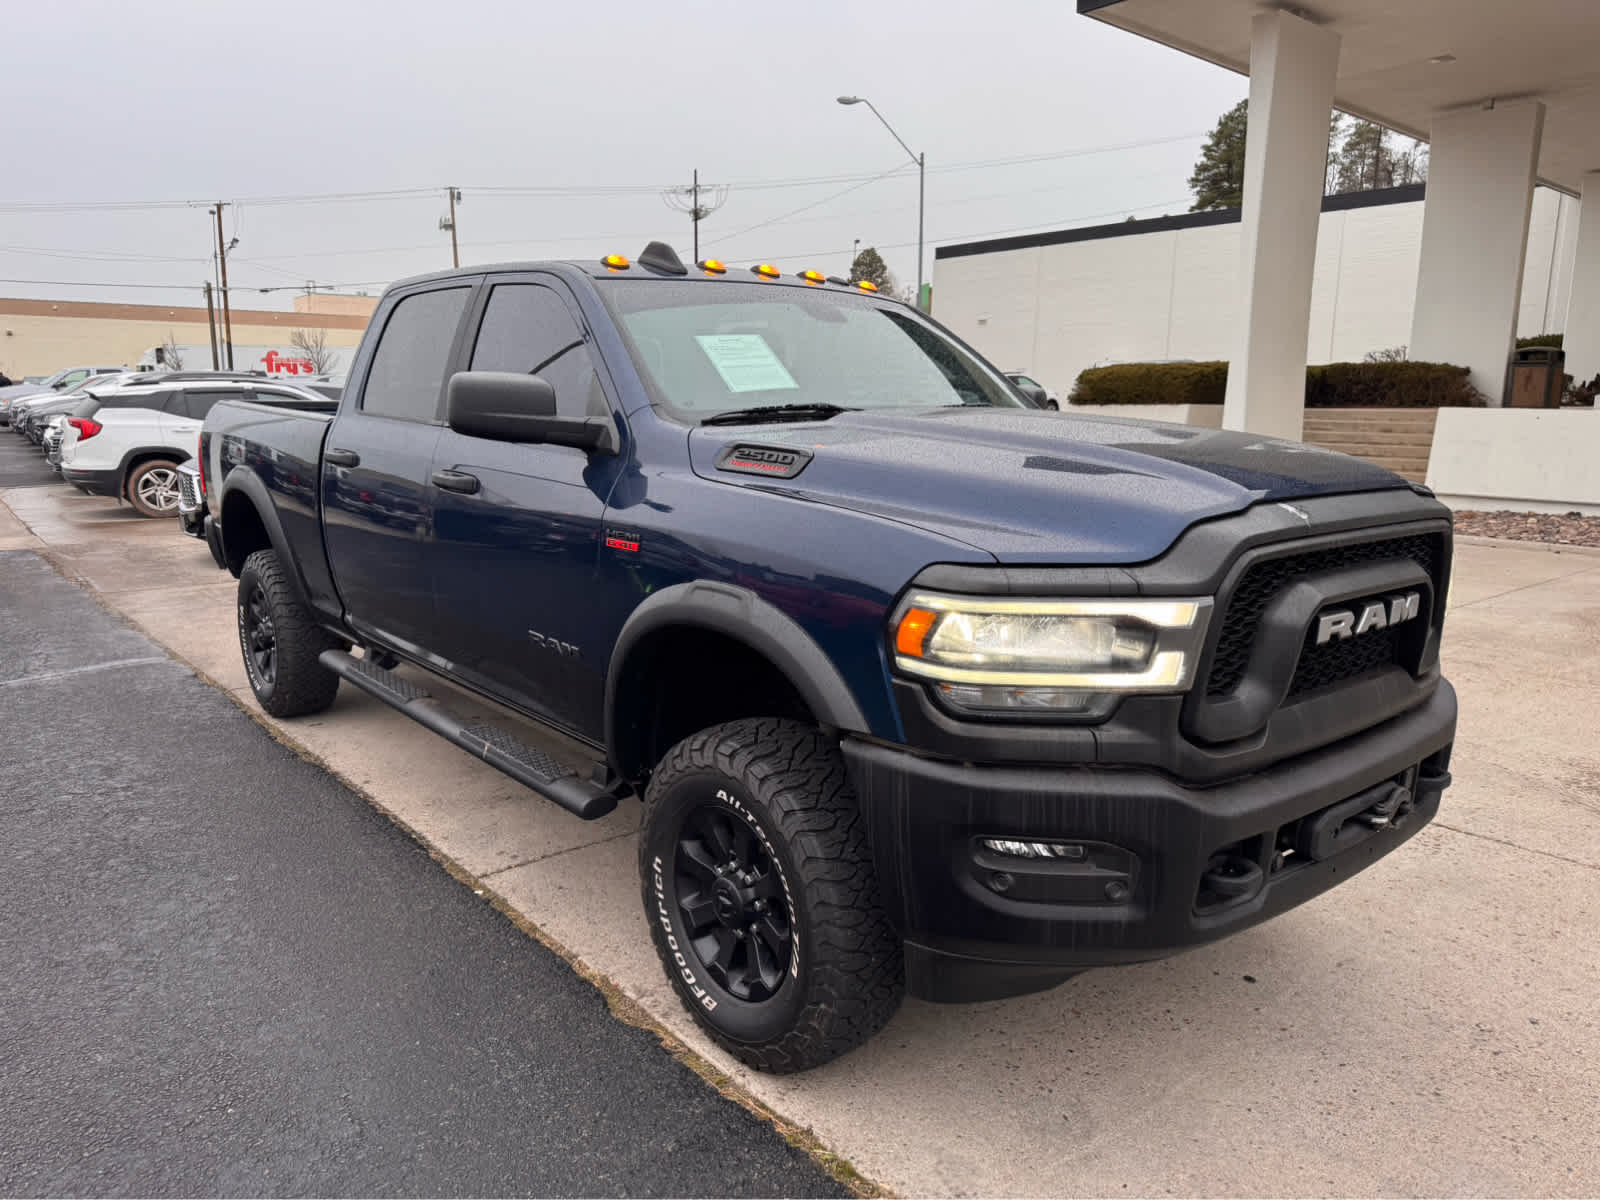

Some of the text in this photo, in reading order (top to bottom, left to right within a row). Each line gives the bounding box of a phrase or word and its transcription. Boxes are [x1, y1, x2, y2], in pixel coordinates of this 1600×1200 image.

[735, 447, 796, 465] 2500
[1316, 592, 1420, 645] RAM
[528, 629, 580, 656] RAM
[652, 855, 718, 1012] BFGoodrich
